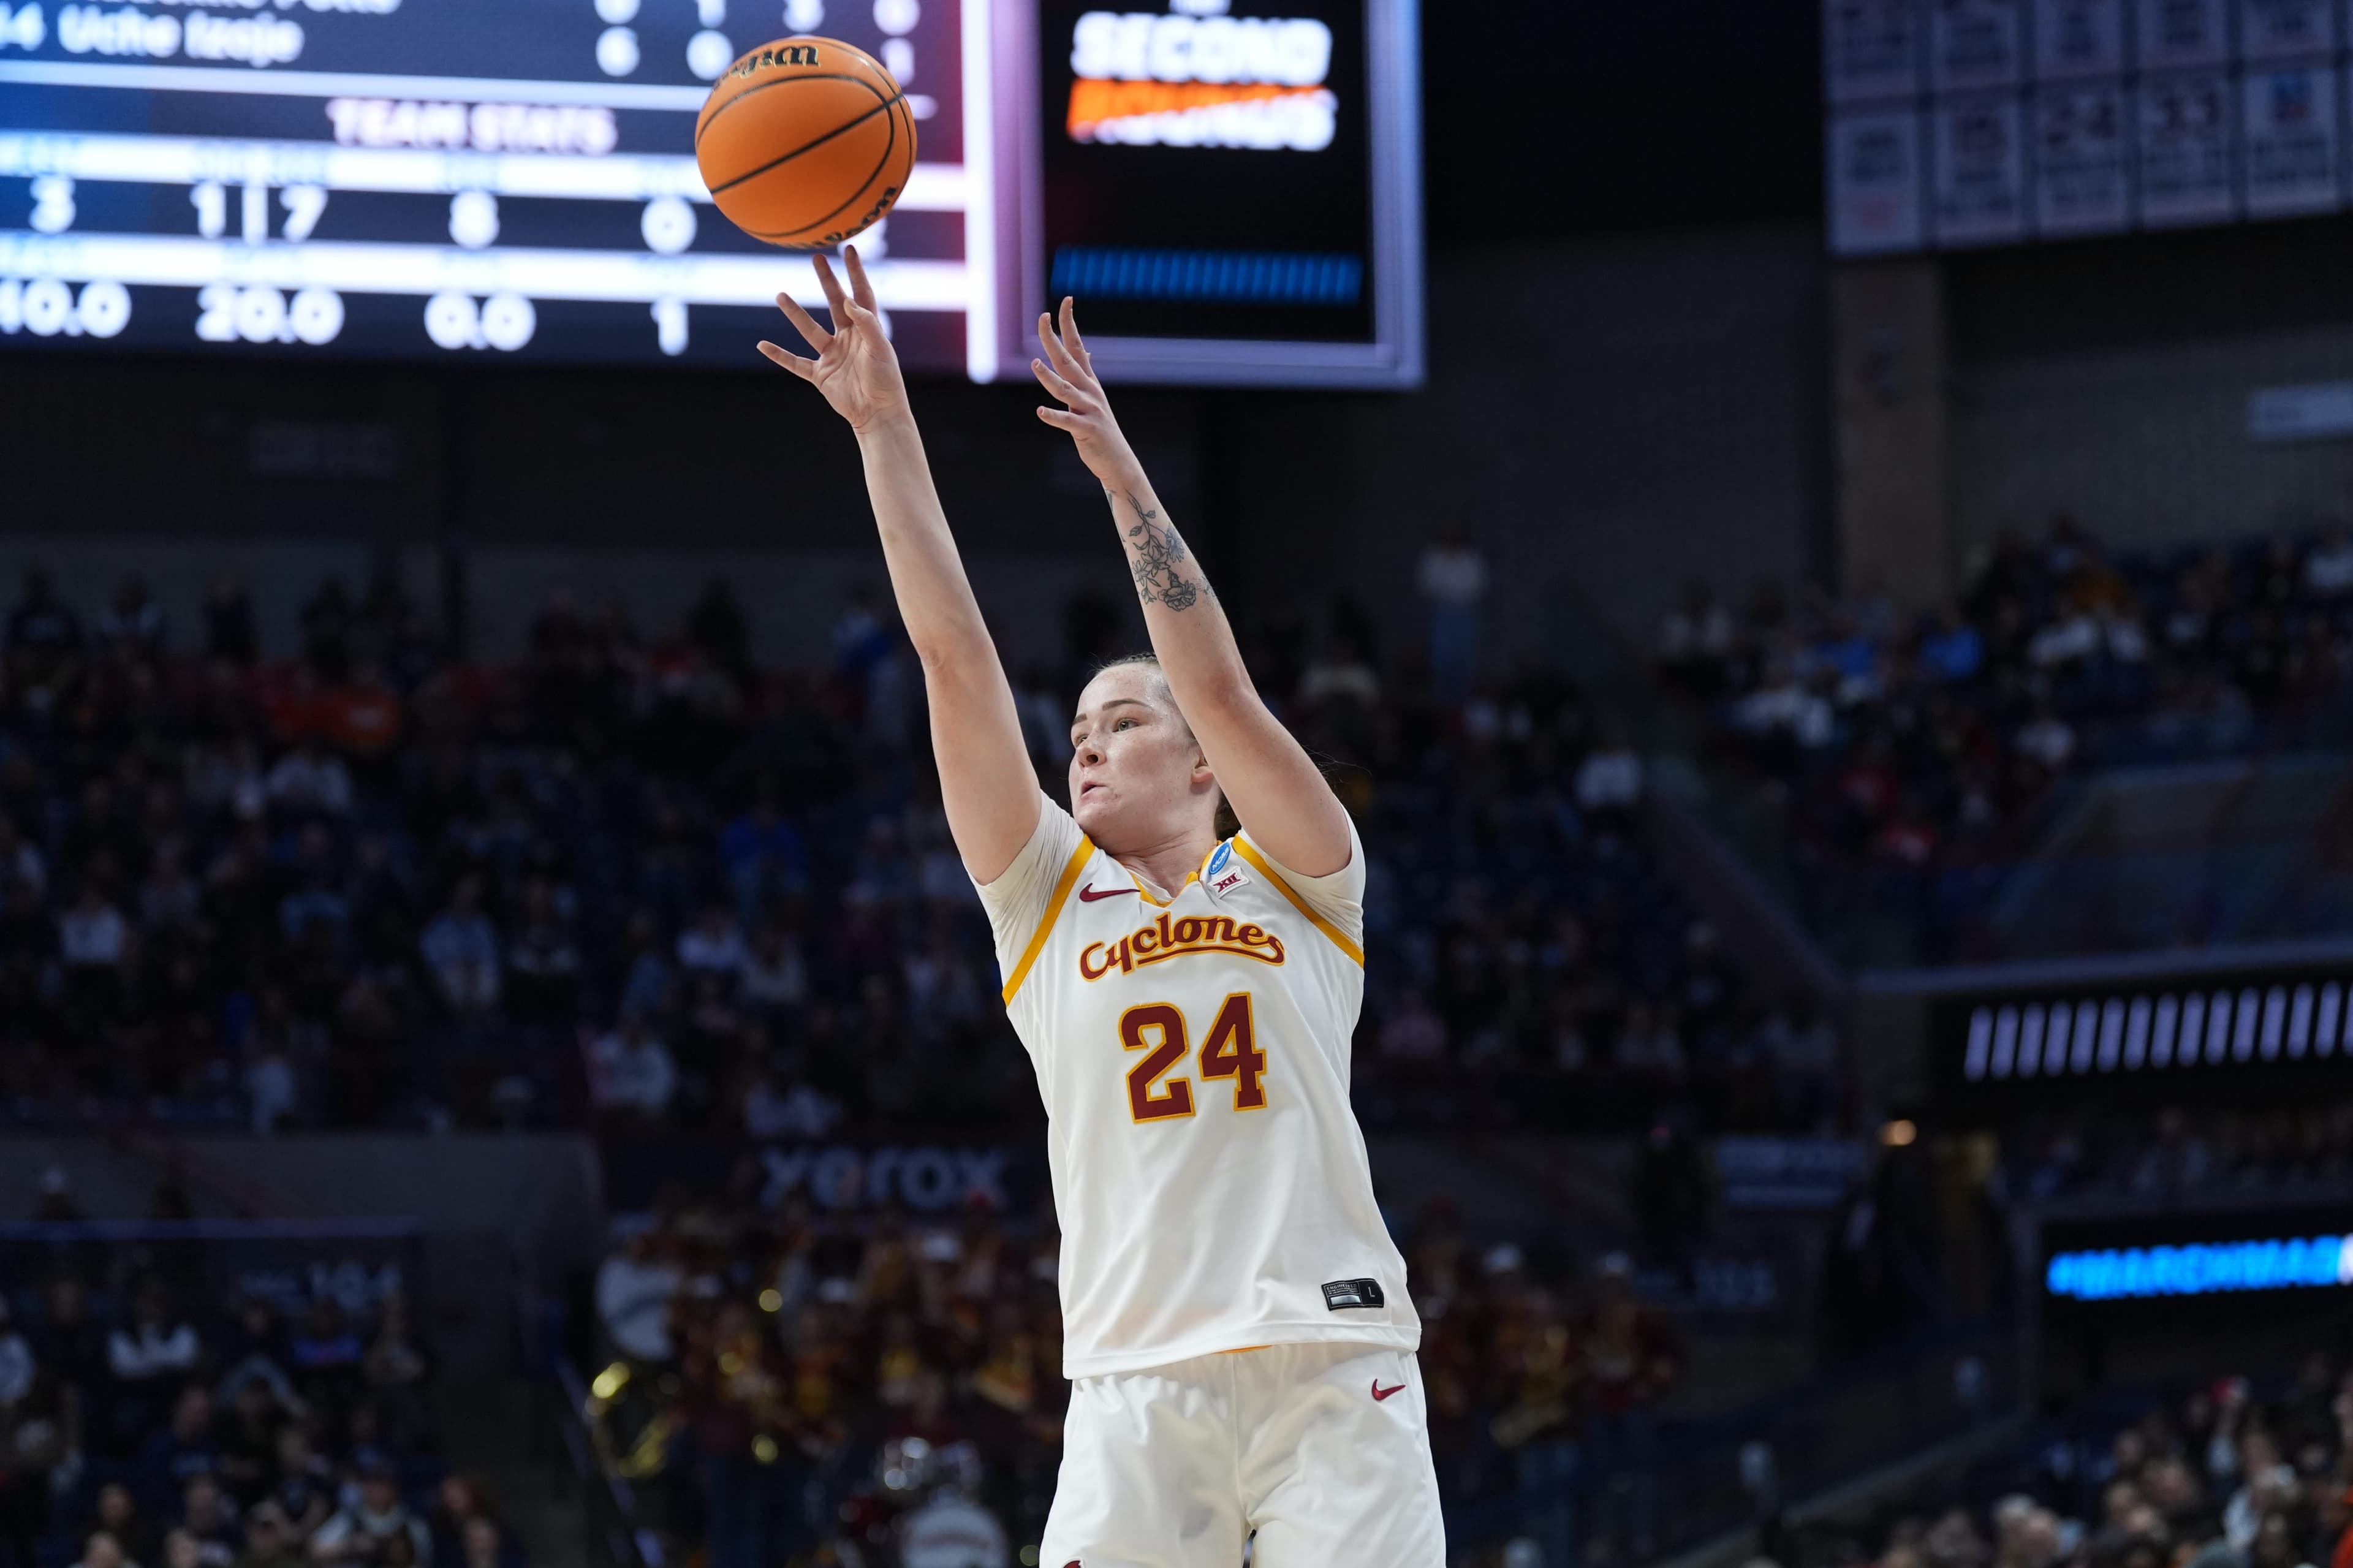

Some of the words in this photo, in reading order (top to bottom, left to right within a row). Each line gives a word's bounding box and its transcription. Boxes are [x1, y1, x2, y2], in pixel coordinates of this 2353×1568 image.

[0, 2, 45, 51] 4
[1070, 12, 1332, 85] SECOND
[712, 45, 820, 93] Wils
[326, 96, 468, 148] TEAM
[470, 100, 618, 156] STATS
[29, 175, 76, 235] 3
[640, 195, 697, 255] 0
[195, 282, 345, 346] 20.0
[424, 291, 537, 352] 0.0
[1079, 911, 1286, 982] Cyclones
[1118, 992, 1267, 1124] 24
[1368, 1287, 1376, 1297] L
